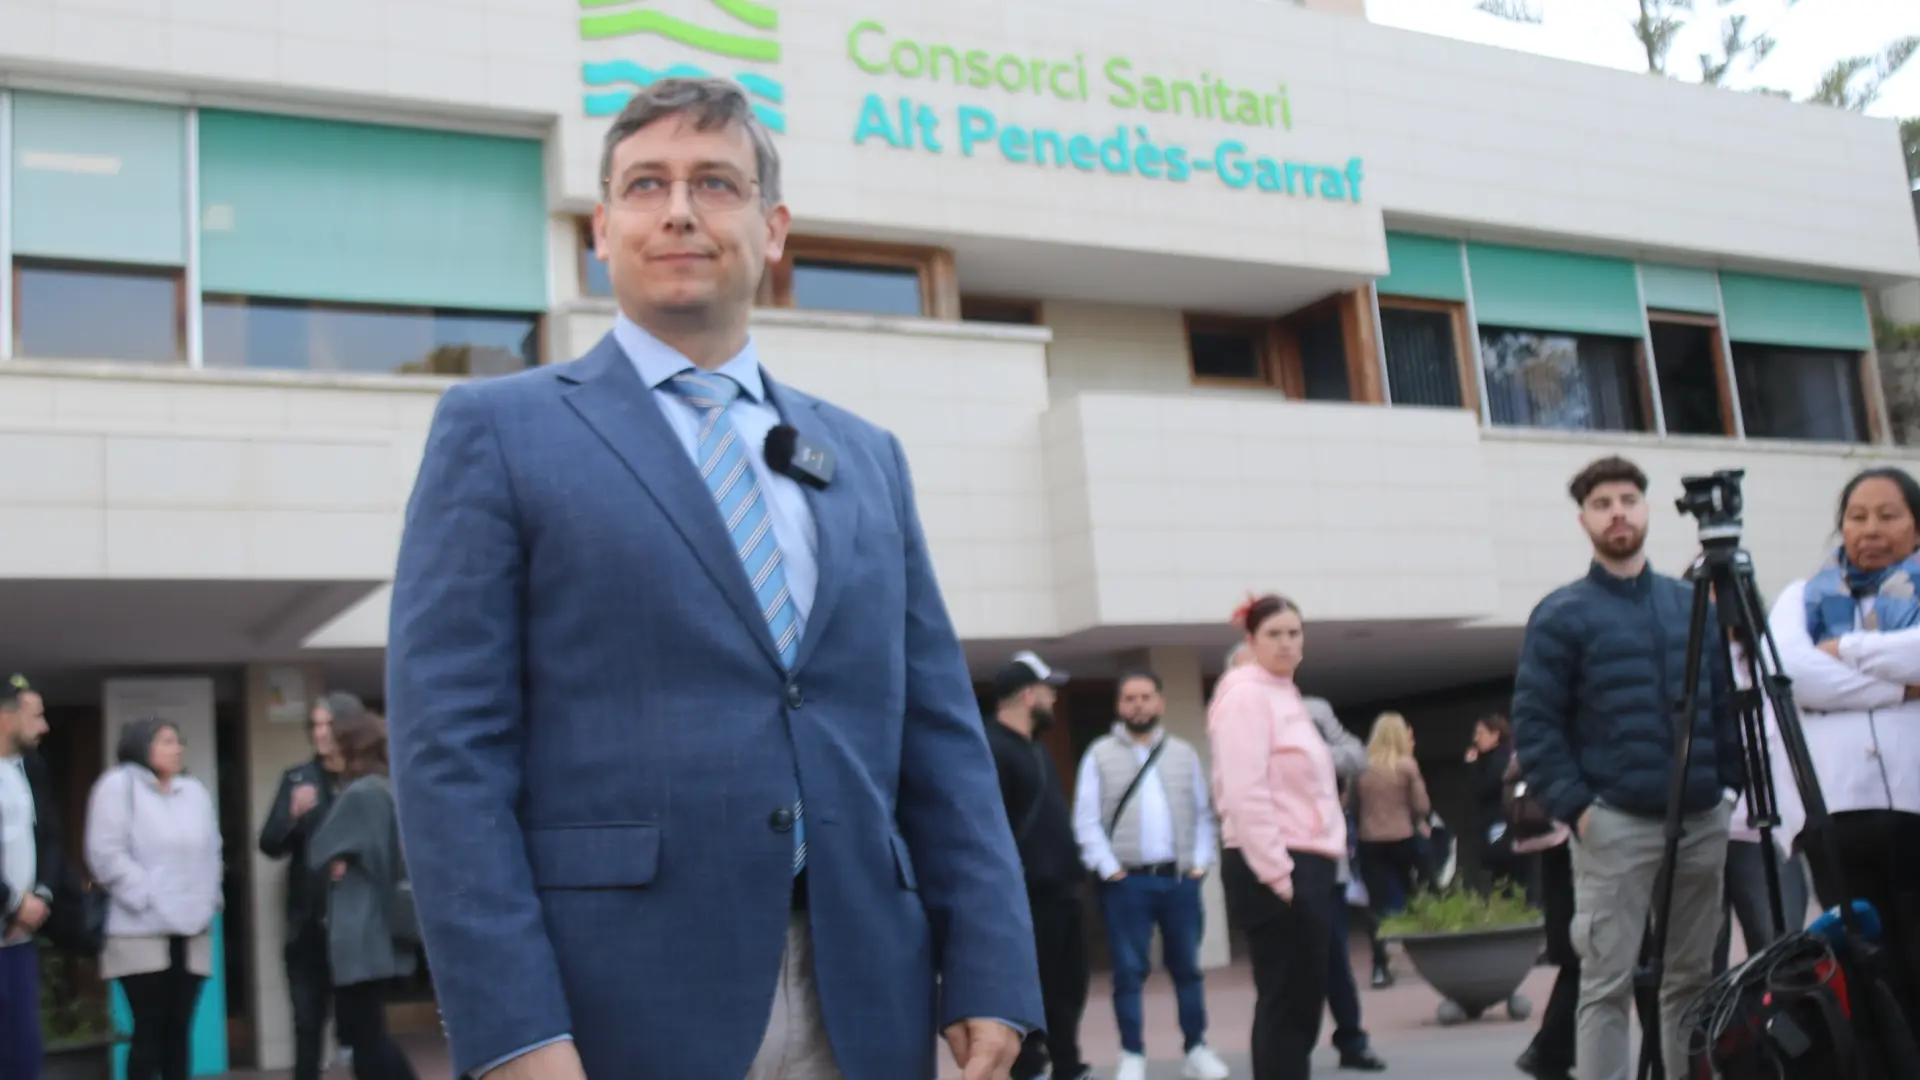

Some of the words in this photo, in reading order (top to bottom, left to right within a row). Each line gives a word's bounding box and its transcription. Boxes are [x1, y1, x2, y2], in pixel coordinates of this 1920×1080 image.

[847, 19, 1089, 101] Consorci
[1103, 57, 1292, 130] Sanitari
[852, 92, 943, 154] Alt
[956, 104, 1364, 202] Penedès-Garraf
